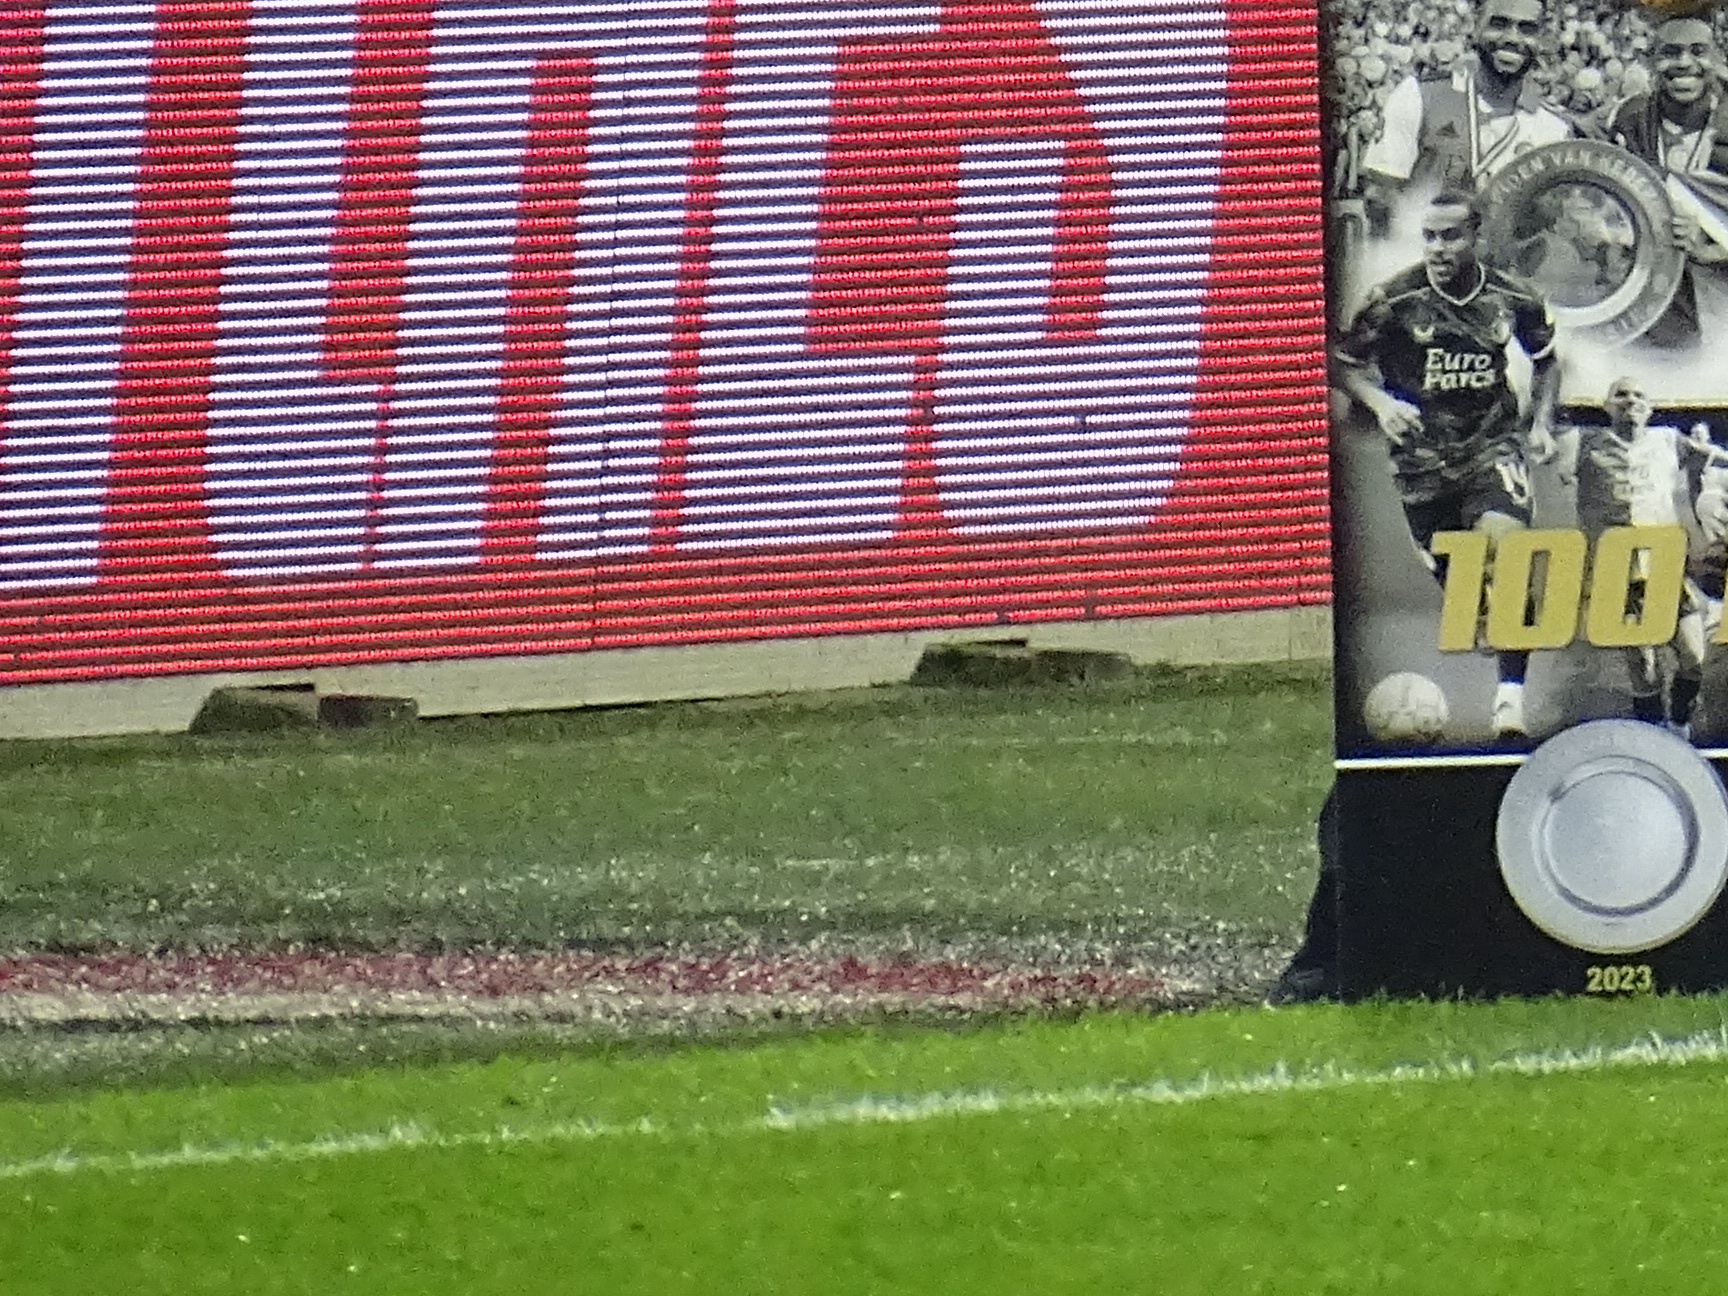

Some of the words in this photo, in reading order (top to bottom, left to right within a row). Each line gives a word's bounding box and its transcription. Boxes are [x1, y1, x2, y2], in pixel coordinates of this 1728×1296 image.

[1426, 348, 1492, 371] Euro
[1432, 527, 1689, 652] 100
[1586, 964, 1653, 993] 2023
